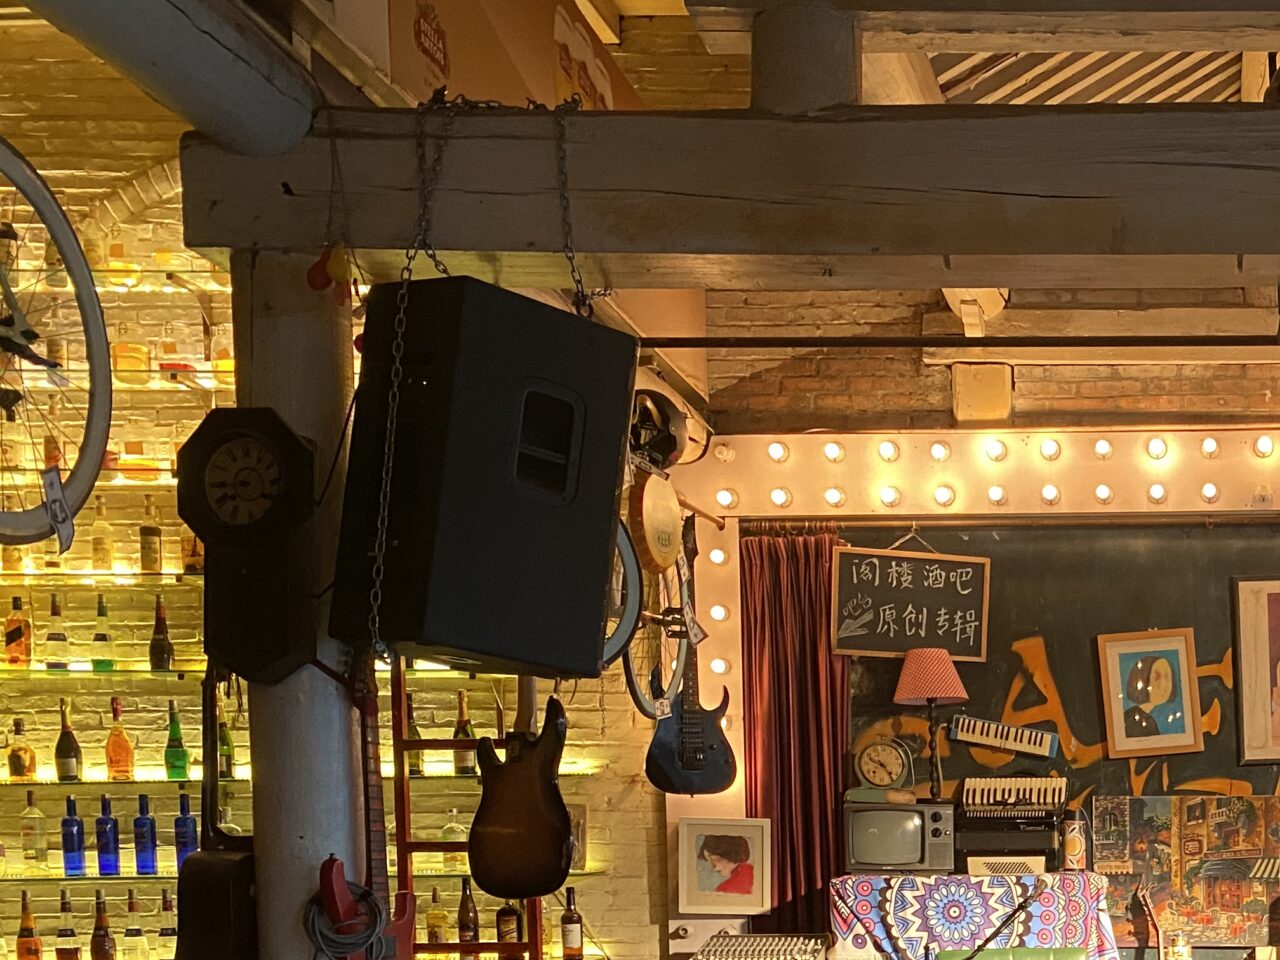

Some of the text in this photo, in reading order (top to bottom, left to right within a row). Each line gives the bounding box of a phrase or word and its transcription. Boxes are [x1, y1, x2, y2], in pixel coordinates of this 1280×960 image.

[420, 16, 444, 51] STELLA
[852, 557, 973, 595] 阁楼酒吧
[876, 603, 980, 646] 原创专辑
